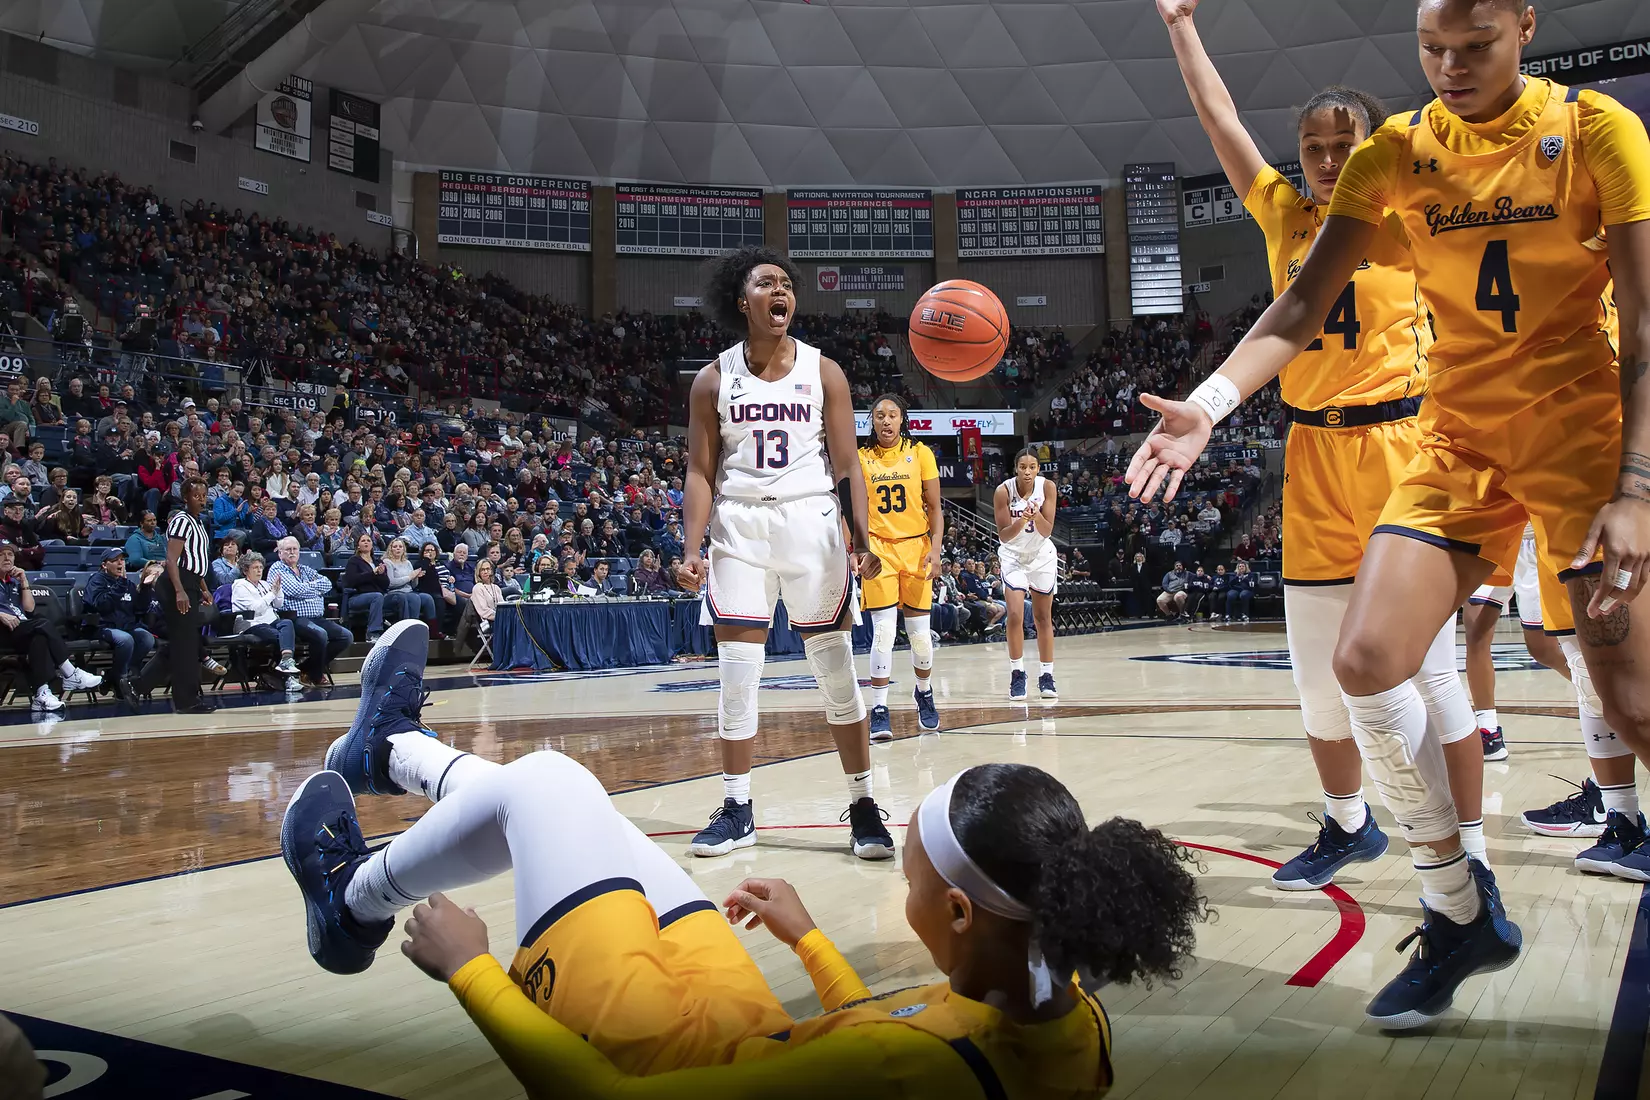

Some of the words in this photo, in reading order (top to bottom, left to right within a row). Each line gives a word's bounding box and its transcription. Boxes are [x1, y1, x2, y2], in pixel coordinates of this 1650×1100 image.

[1519, 55, 1573, 75] RSITY
[1579, 50, 1603, 66] OF
[0, 117, 13, 125] SEC
[18, 120, 37, 132] 210
[1547, 146, 1558, 156] 12
[256, 183, 268, 193] 211
[442, 173, 463, 181] BIG
[470, 174, 502, 184] EAST
[508, 178, 587, 190] CONFERENCE
[442, 183, 486, 191] REGULAR
[491, 186, 528, 194] SEASON
[533, 189, 588, 198] CHAMPIONS
[1003, 188, 1093, 197] CHAMPIONSHIP
[464, 193, 480, 204] 1994
[486, 195, 502, 205] 1995
[552, 199, 567, 210] 1999
[572, 201, 588, 211] 2002
[630, 195, 692, 203] TOURNAMENT
[696, 197, 750, 205] CHAMPIONS
[1029, 197, 1095, 205] APPEARANCES
[441, 207, 458, 218] 2003
[463, 208, 481, 219] 2005
[640, 204, 655, 214] 1996
[683, 206, 698, 216] 1999
[703, 206, 719, 217] 2002
[724, 207, 740, 217] 2004
[745, 208, 760, 218] 2011
[790, 209, 806, 219] 1955
[812, 209, 826, 219] 1974
[832, 209, 847, 219] 1975
[960, 209, 974, 218] 1951
[980, 208, 996, 218] 1954
[1001, 208, 1016, 217] 1956
[1022, 207, 1037, 217] 1957
[1192, 206, 1204, 219] C
[1224, 201, 1232, 214] 9
[380, 216, 392, 224] 212
[1424, 202, 1489, 236] Golden
[1492, 196, 1557, 221] Bears
[619, 218, 634, 228] 2016
[812, 224, 827, 234] 1993
[832, 224, 847, 234] 1997
[894, 224, 909, 234] 2015
[960, 223, 976, 233] 1963
[1023, 221, 1038, 231] 1967
[442, 236, 501, 245] CONNECTICUT
[534, 242, 586, 250] BASKETBALL
[961, 238, 976, 247] 1991
[982, 237, 997, 247] 1992
[1002, 237, 1018, 246] 1994
[1086, 234, 1101, 243] 1999
[1475, 240, 1520, 332] 4
[922, 308, 965, 329] ELITE
[292, 397, 316, 410] 109
[730, 403, 811, 423] UCONN
[909, 420, 932, 430] AZ
[753, 430, 788, 469] 13
[1242, 449, 1258, 457] 113
[877, 484, 906, 514] 33
[1025, 521, 1034, 533] 3
